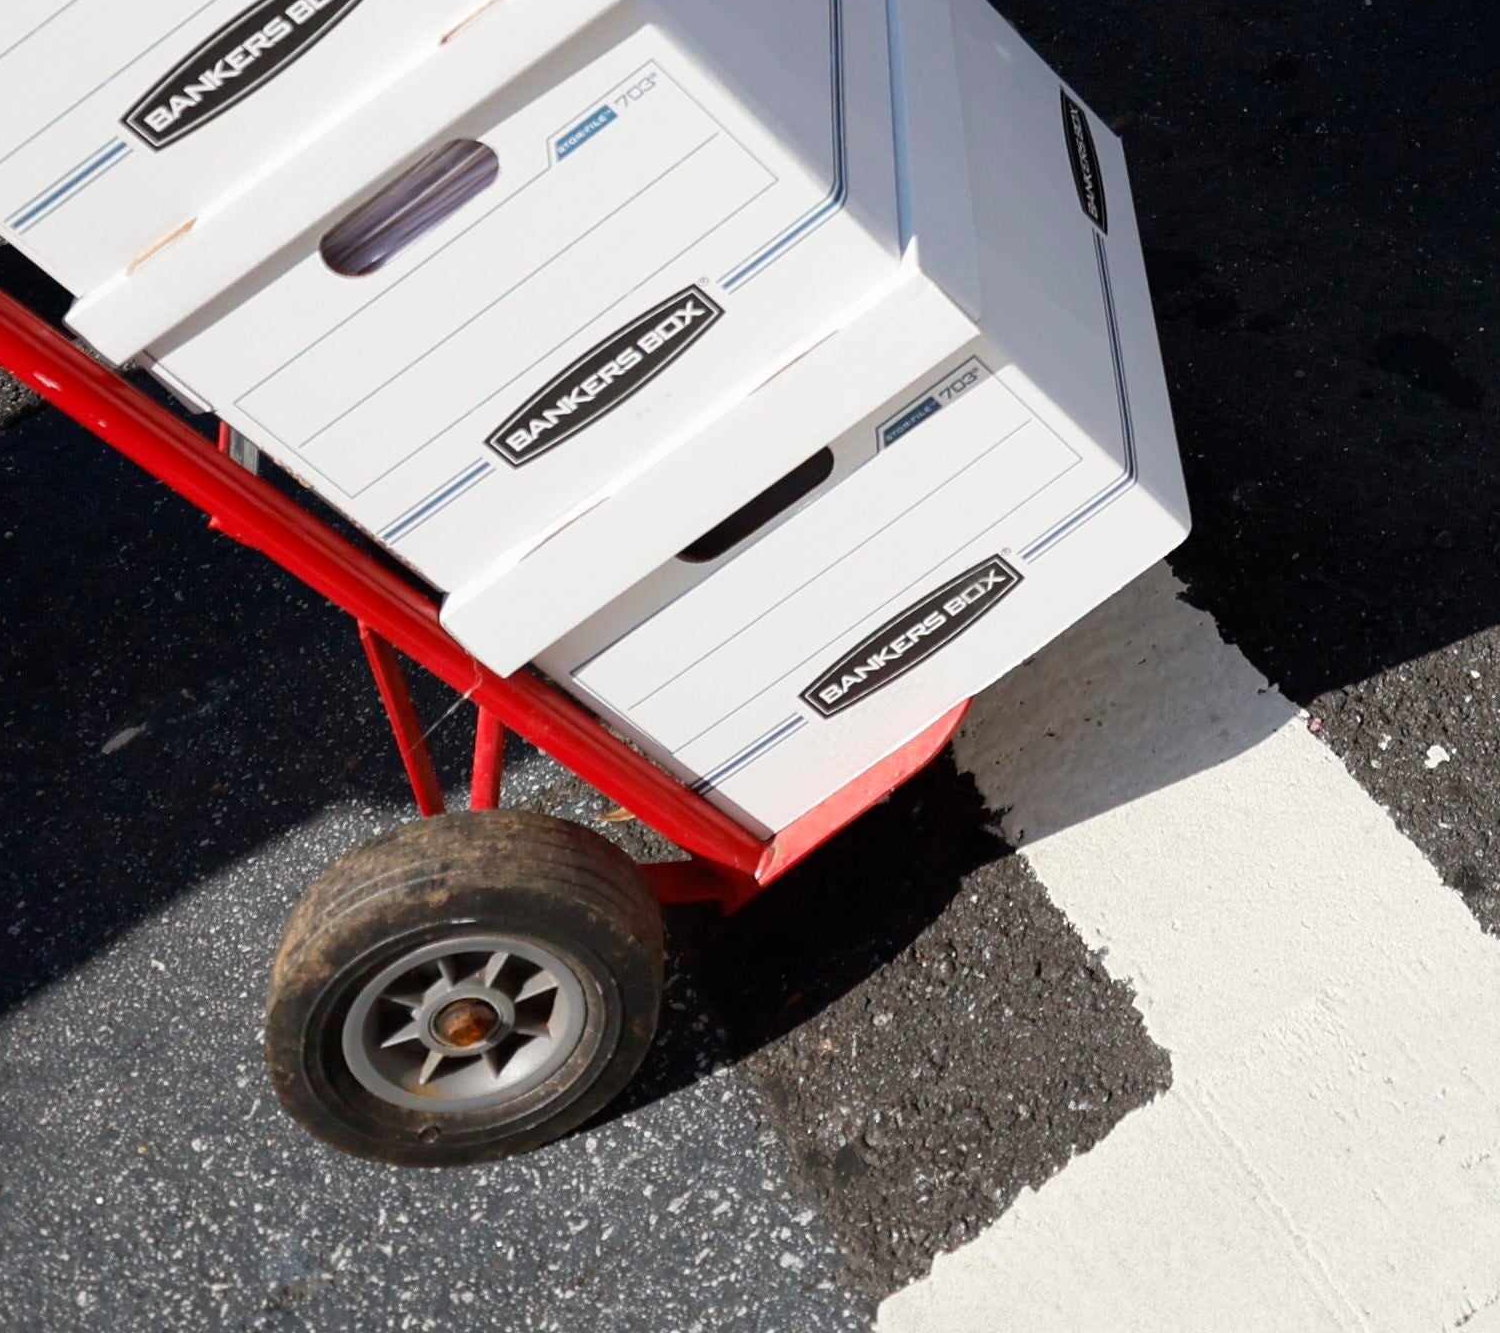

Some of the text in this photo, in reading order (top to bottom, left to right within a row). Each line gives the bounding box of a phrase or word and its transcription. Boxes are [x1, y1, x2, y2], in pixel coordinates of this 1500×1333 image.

[144, 15, 292, 132] BANKERS
[505, 300, 706, 453] BANKERS BOX
[819, 569, 1006, 704] BANKERS BOX
